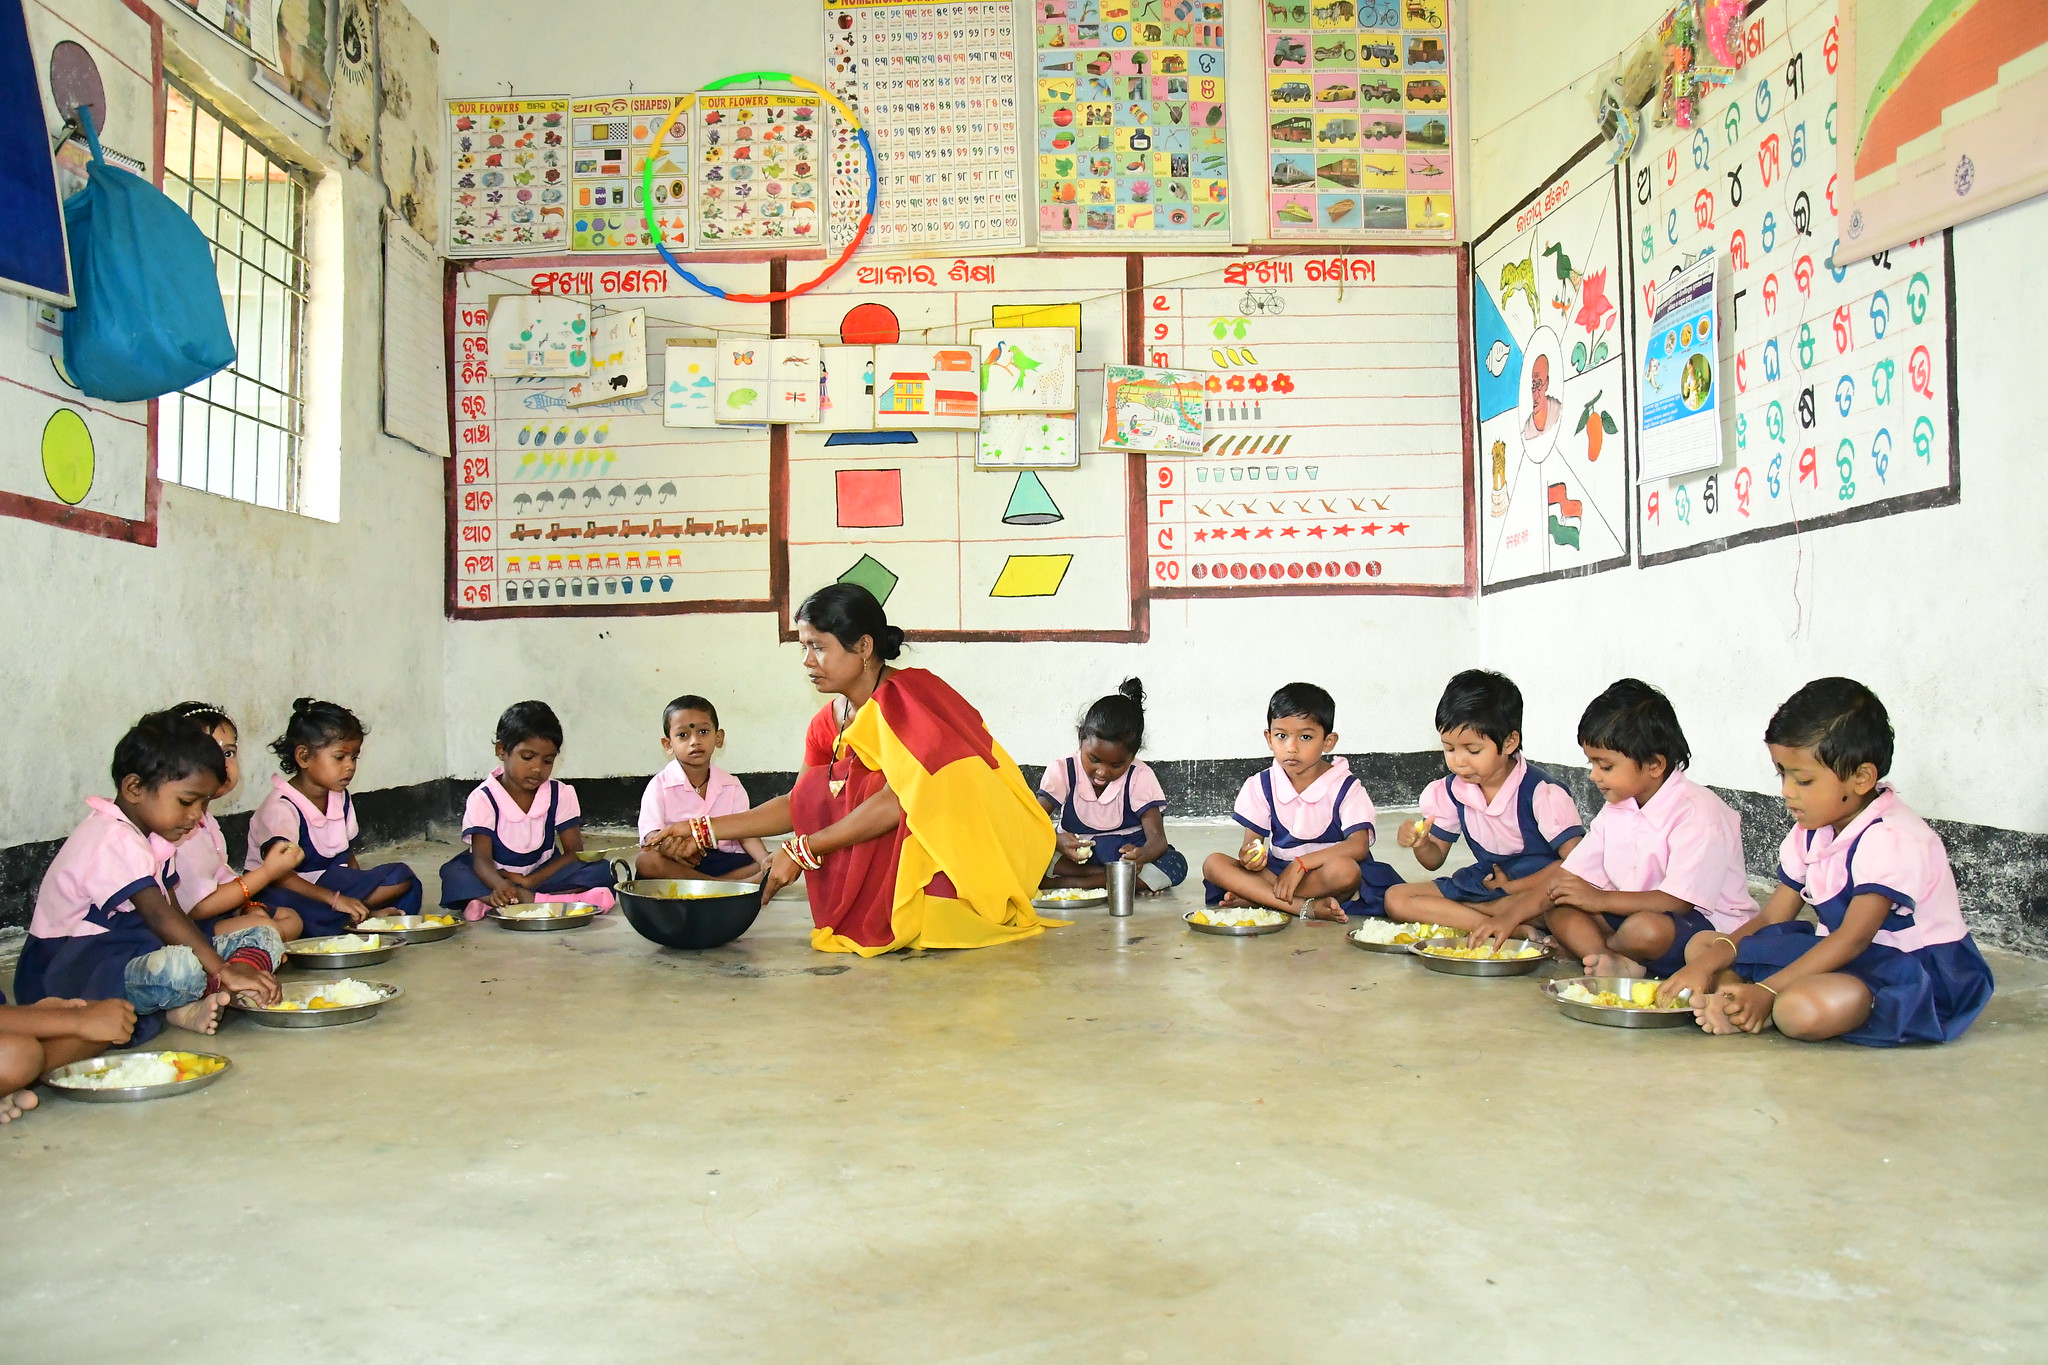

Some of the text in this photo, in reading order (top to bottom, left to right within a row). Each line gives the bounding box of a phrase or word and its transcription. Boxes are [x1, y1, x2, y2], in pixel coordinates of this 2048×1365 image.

[1199, 54, 1215, 73] ଙ
[458, 103, 520, 113] OUR FLOWERS
[573, 99, 671, 115] ଆକୃତି (SHAPES)
[708, 97, 769, 108] OUR FLOWERS
[1637, 166, 1651, 205] ଅ
[1723, 102, 1740, 146] ନ
[1756, 79, 1771, 124] ଓ
[1786, 52, 1804, 100] ୩
[1668, 208, 1678, 245] ୧
[1728, 164, 1742, 207] ୪
[1730, 229, 1749, 272] ଲ
[531, 270, 667, 295] ସଂଖ୍ୟା ଗଣନା
[857, 259, 995, 286] ଆକାର ଶିକ୍ଷା
[1224, 258, 1375, 286] ସଂଖ୍ୟା ଗଣନା
[1152, 295, 1170, 312] ୧
[1734, 289, 1746, 332] ୮
[1154, 322, 1169, 340] ୨
[1833, 302, 1854, 354] ଖ
[462, 361, 488, 384] ତିନି
[1872, 357, 1894, 406] ଫ
[464, 457, 490, 484] ଛଅ
[1158, 466, 1174, 489] ୭
[1733, 464, 1752, 518] ହ
[1767, 453, 1782, 498] ଙ
[1836, 438, 1855, 500] ଛ
[465, 491, 493, 512] ସାତ
[1159, 500, 1174, 517] ୮
[462, 525, 492, 543] ଆଠ
[1158, 527, 1173, 550] ୯
[464, 555, 494, 575] ନଅ
[1156, 560, 1180, 581] ୧୦
[464, 584, 491, 604] ଦଶ
